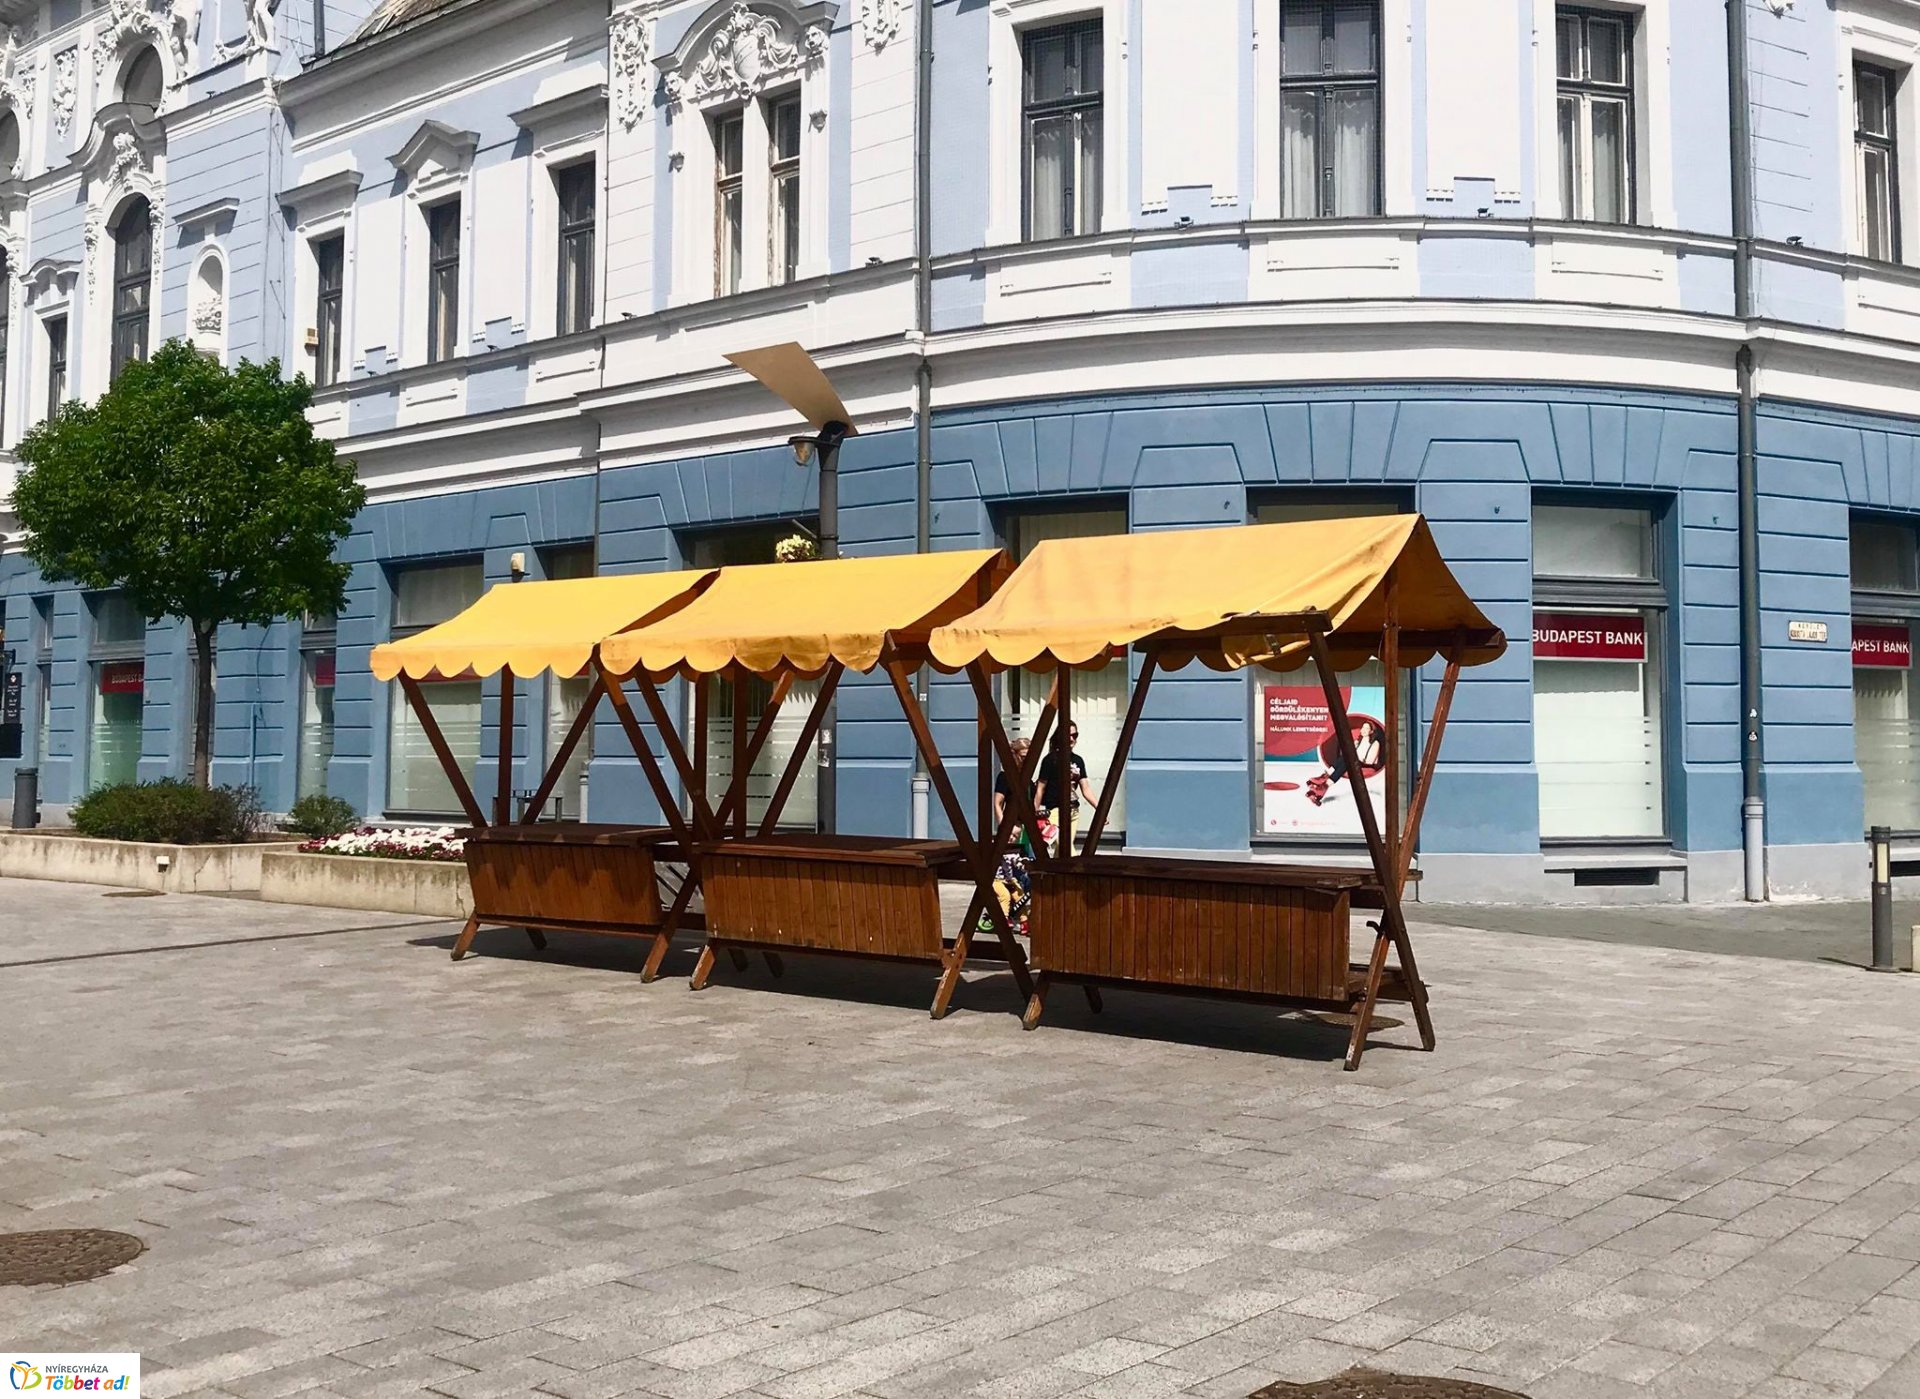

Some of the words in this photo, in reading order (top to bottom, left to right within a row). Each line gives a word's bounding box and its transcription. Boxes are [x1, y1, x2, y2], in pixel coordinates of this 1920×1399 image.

[1532, 629, 1602, 644] BUDAPEST
[1605, 631, 1643, 645] BANK
[1883, 640, 1909, 653] BANK
